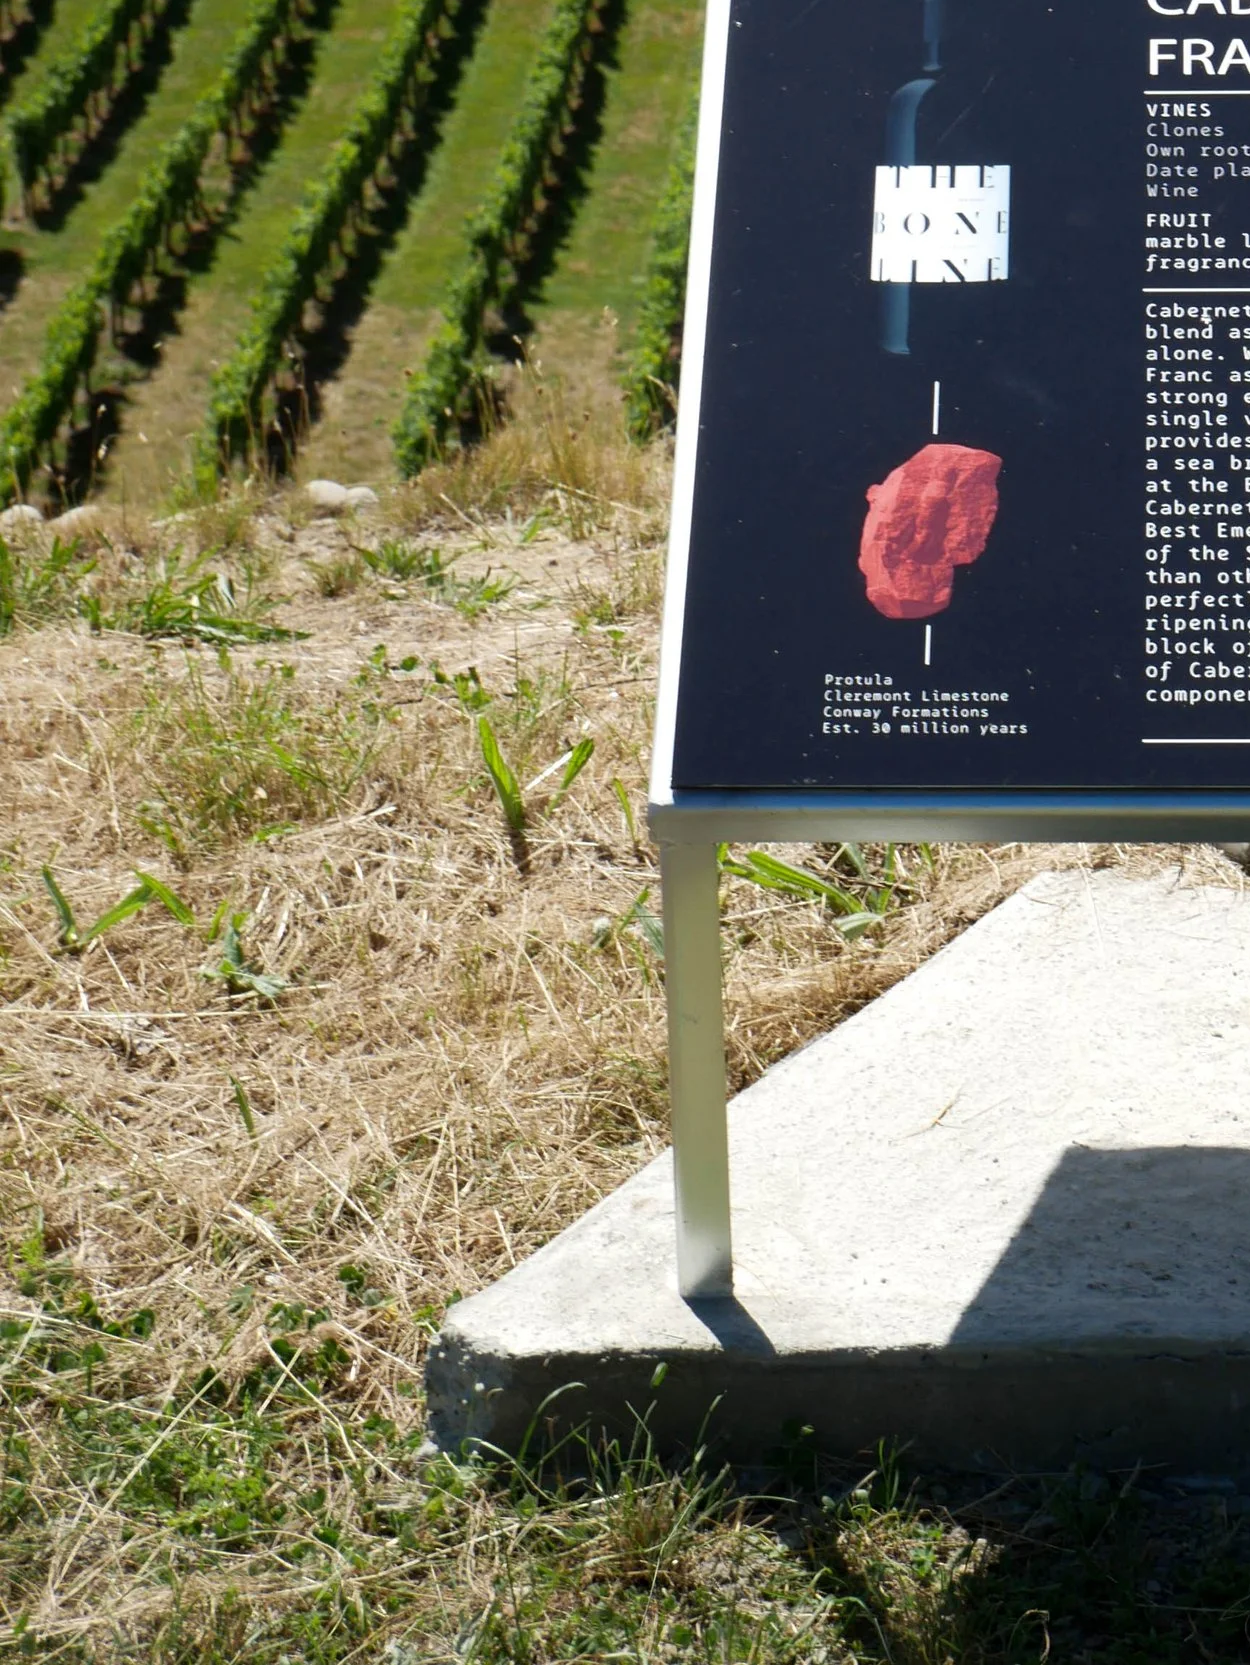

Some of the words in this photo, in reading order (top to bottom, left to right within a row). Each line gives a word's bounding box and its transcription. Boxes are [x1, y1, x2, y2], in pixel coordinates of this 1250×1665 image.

[1146, 103, 1211, 117] VINES
[1147, 122, 1224, 137] Clones
[1146, 143, 1185, 157] Own
[889, 165, 995, 188] THE
[1146, 163, 1198, 177] Date
[1146, 183, 1199, 197] Wine
[874, 211, 1007, 235] BONE
[1147, 213, 1211, 228] FRUIT
[1145, 233, 1226, 248] marble
[879, 258, 1001, 282] LINE
[1146, 322, 1213, 339] blend
[1146, 345, 1224, 361] alone.
[1146, 368, 1213, 382] Franc
[1146, 391, 1227, 407] strong
[1146, 410, 1228, 429] single
[1146, 459, 1158, 470] a
[1174, 459, 1214, 470] sea
[1146, 479, 1172, 492] at
[1188, 477, 1228, 492] the
[1146, 522, 1200, 538] Best
[1145, 544, 1172, 564] of
[1189, 545, 1229, 561] the
[1146, 568, 1201, 584] than
[1146, 637, 1215, 654] block
[825, 673, 892, 685] Protula
[1145, 661, 1172, 682] of
[824, 689, 911, 701] Cleremont
[922, 690, 1009, 701] Limestone
[823, 706, 881, 719] Conway
[892, 705, 989, 717] Formations
[823, 722, 859, 733] Est.
[872, 722, 891, 733] 30
[901, 721, 969, 733] million
[980, 724, 1027, 736] years
